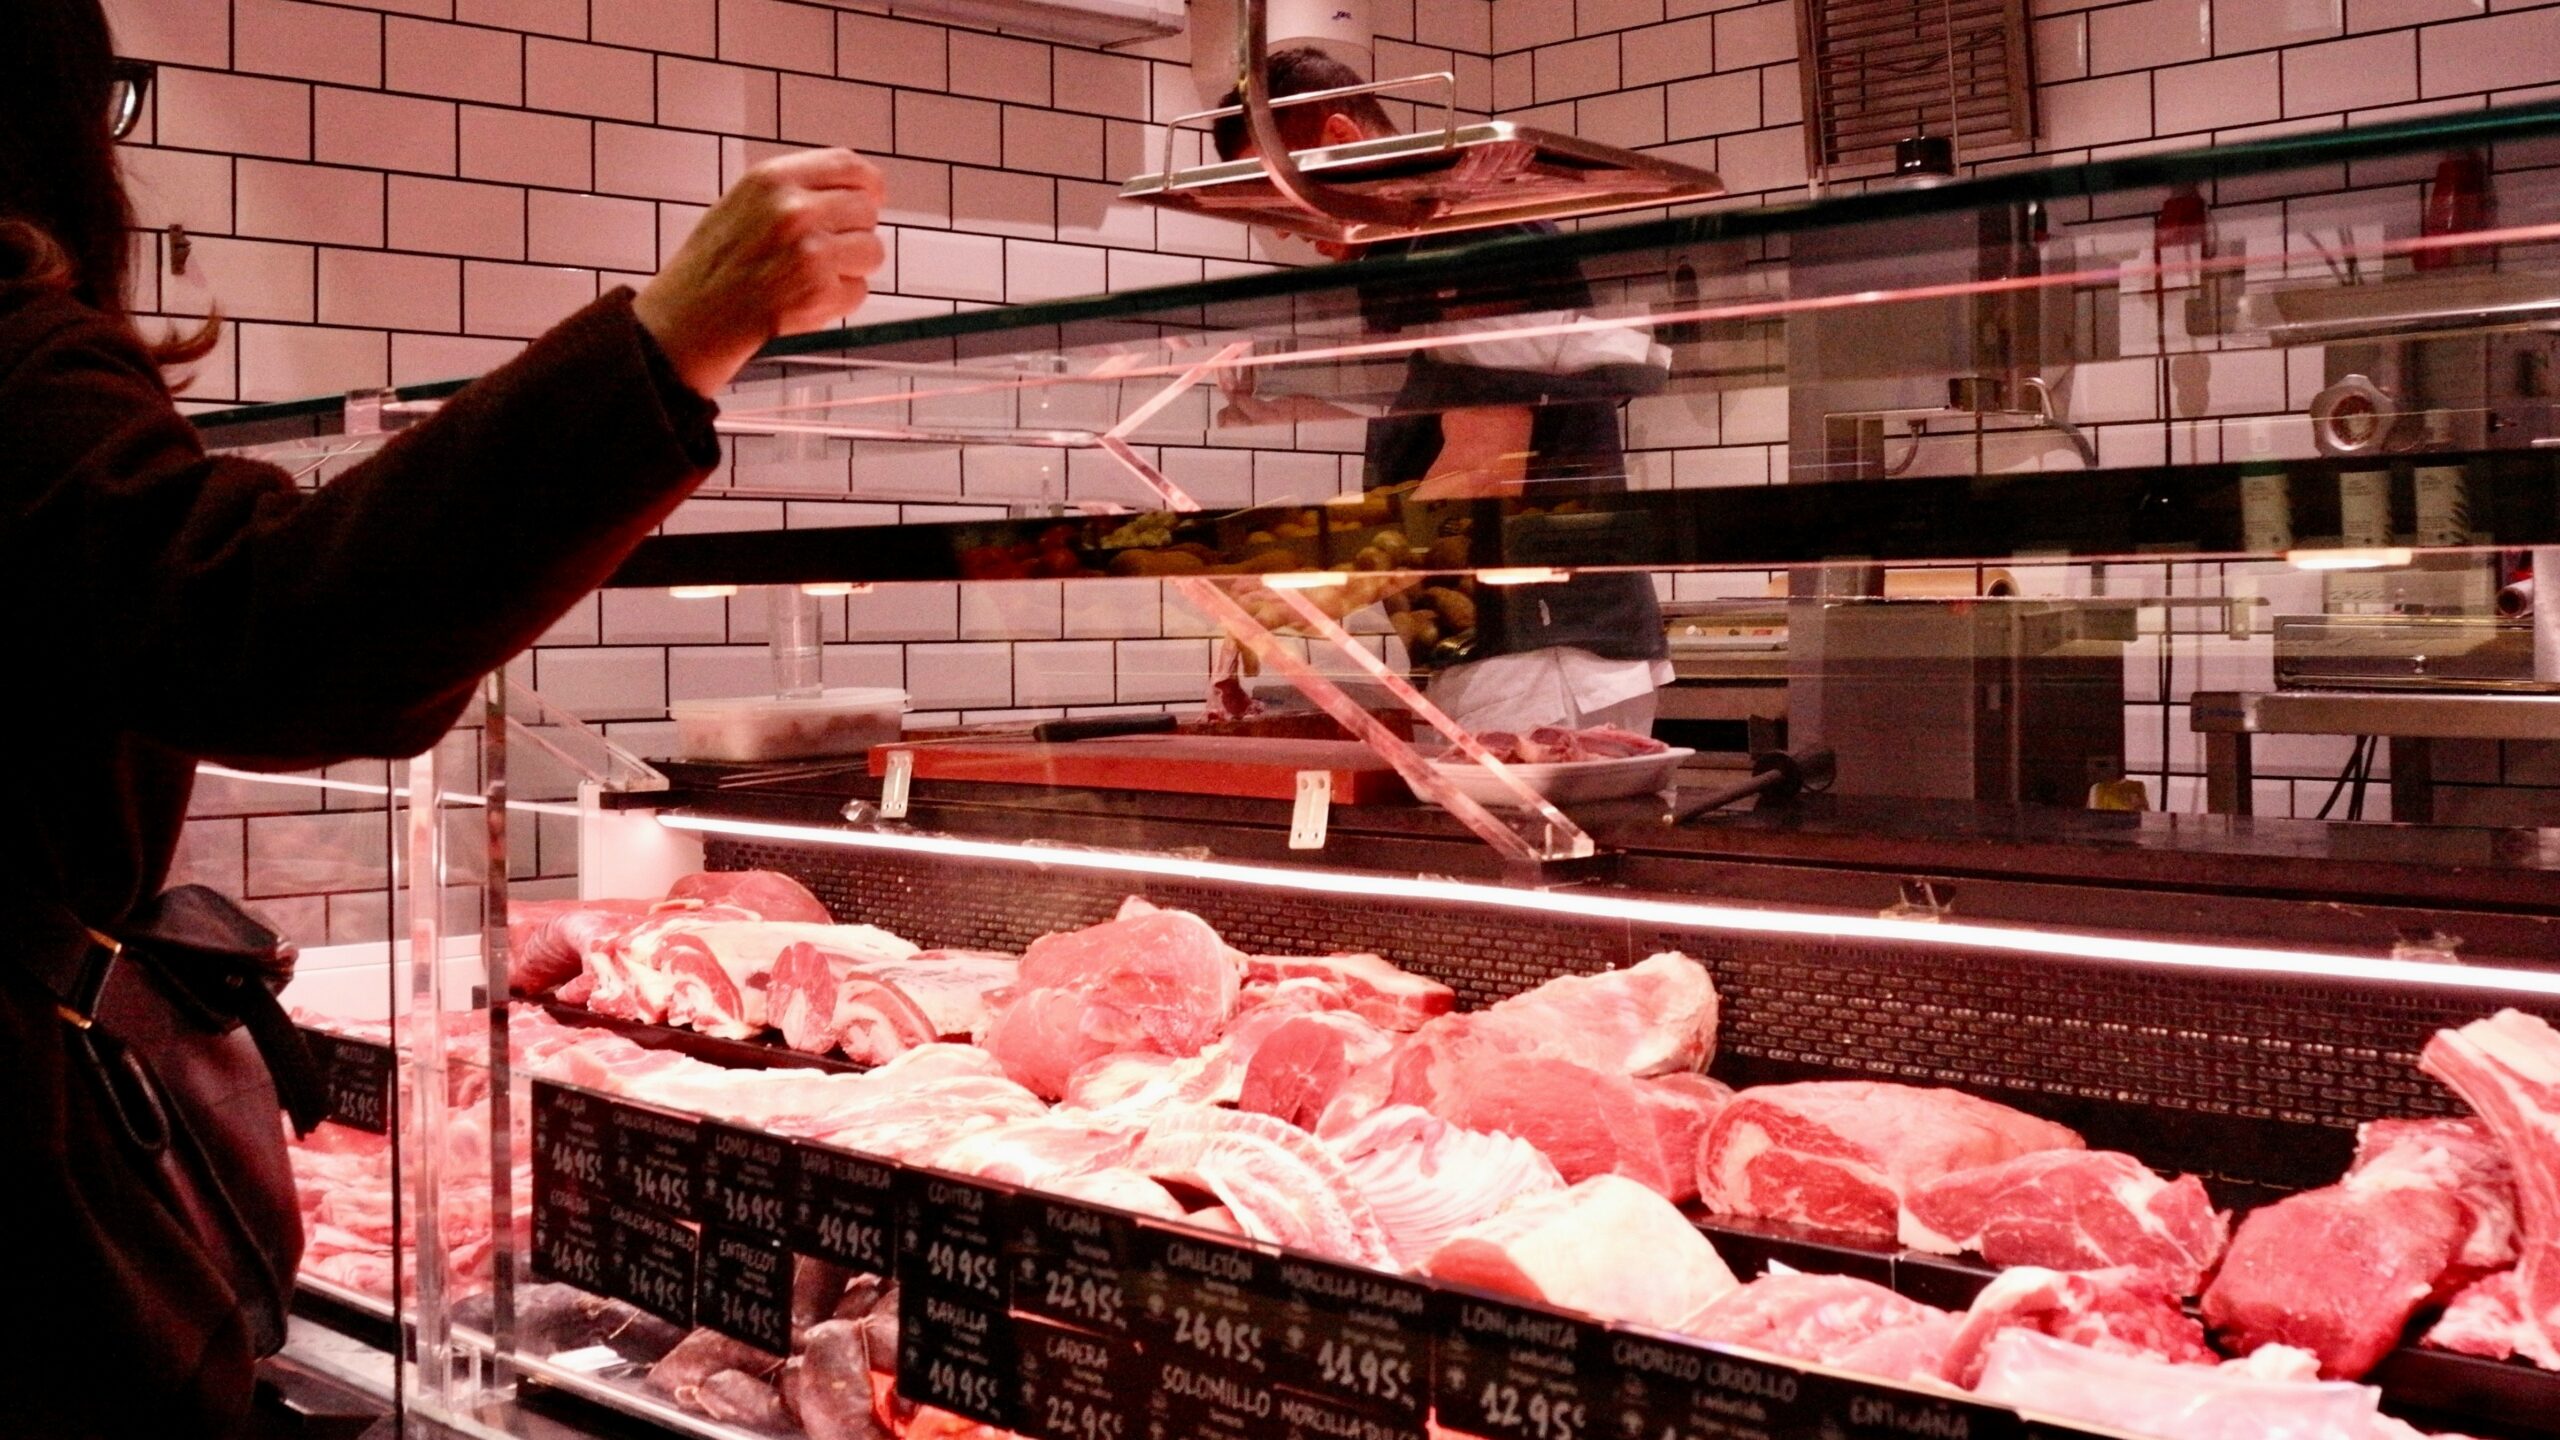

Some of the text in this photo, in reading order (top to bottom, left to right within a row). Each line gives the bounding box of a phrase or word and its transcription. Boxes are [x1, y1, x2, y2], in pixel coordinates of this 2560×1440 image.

[715, 1133, 749, 1160] LOMO
[752, 1141, 781, 1168] ALTO
[801, 1151, 830, 1176] TAPA
[833, 1159, 892, 1191] TERNERA
[928, 1181, 985, 1213] CONTRA
[1046, 1206, 1102, 1237] PICAÑA
[719, 1238, 777, 1273] ENTRECOT
[1167, 1242, 1252, 1283] CHULETÓN
[1280, 1263, 1357, 1299] MORCILLA
[1046, 1335, 1109, 1371] CADERA
[1612, 1338, 1797, 1403] CHORIZO CRIOLLO
[1162, 1363, 1271, 1418] SOLOMILLO
[1280, 1400, 1361, 1439] MORCILLA
